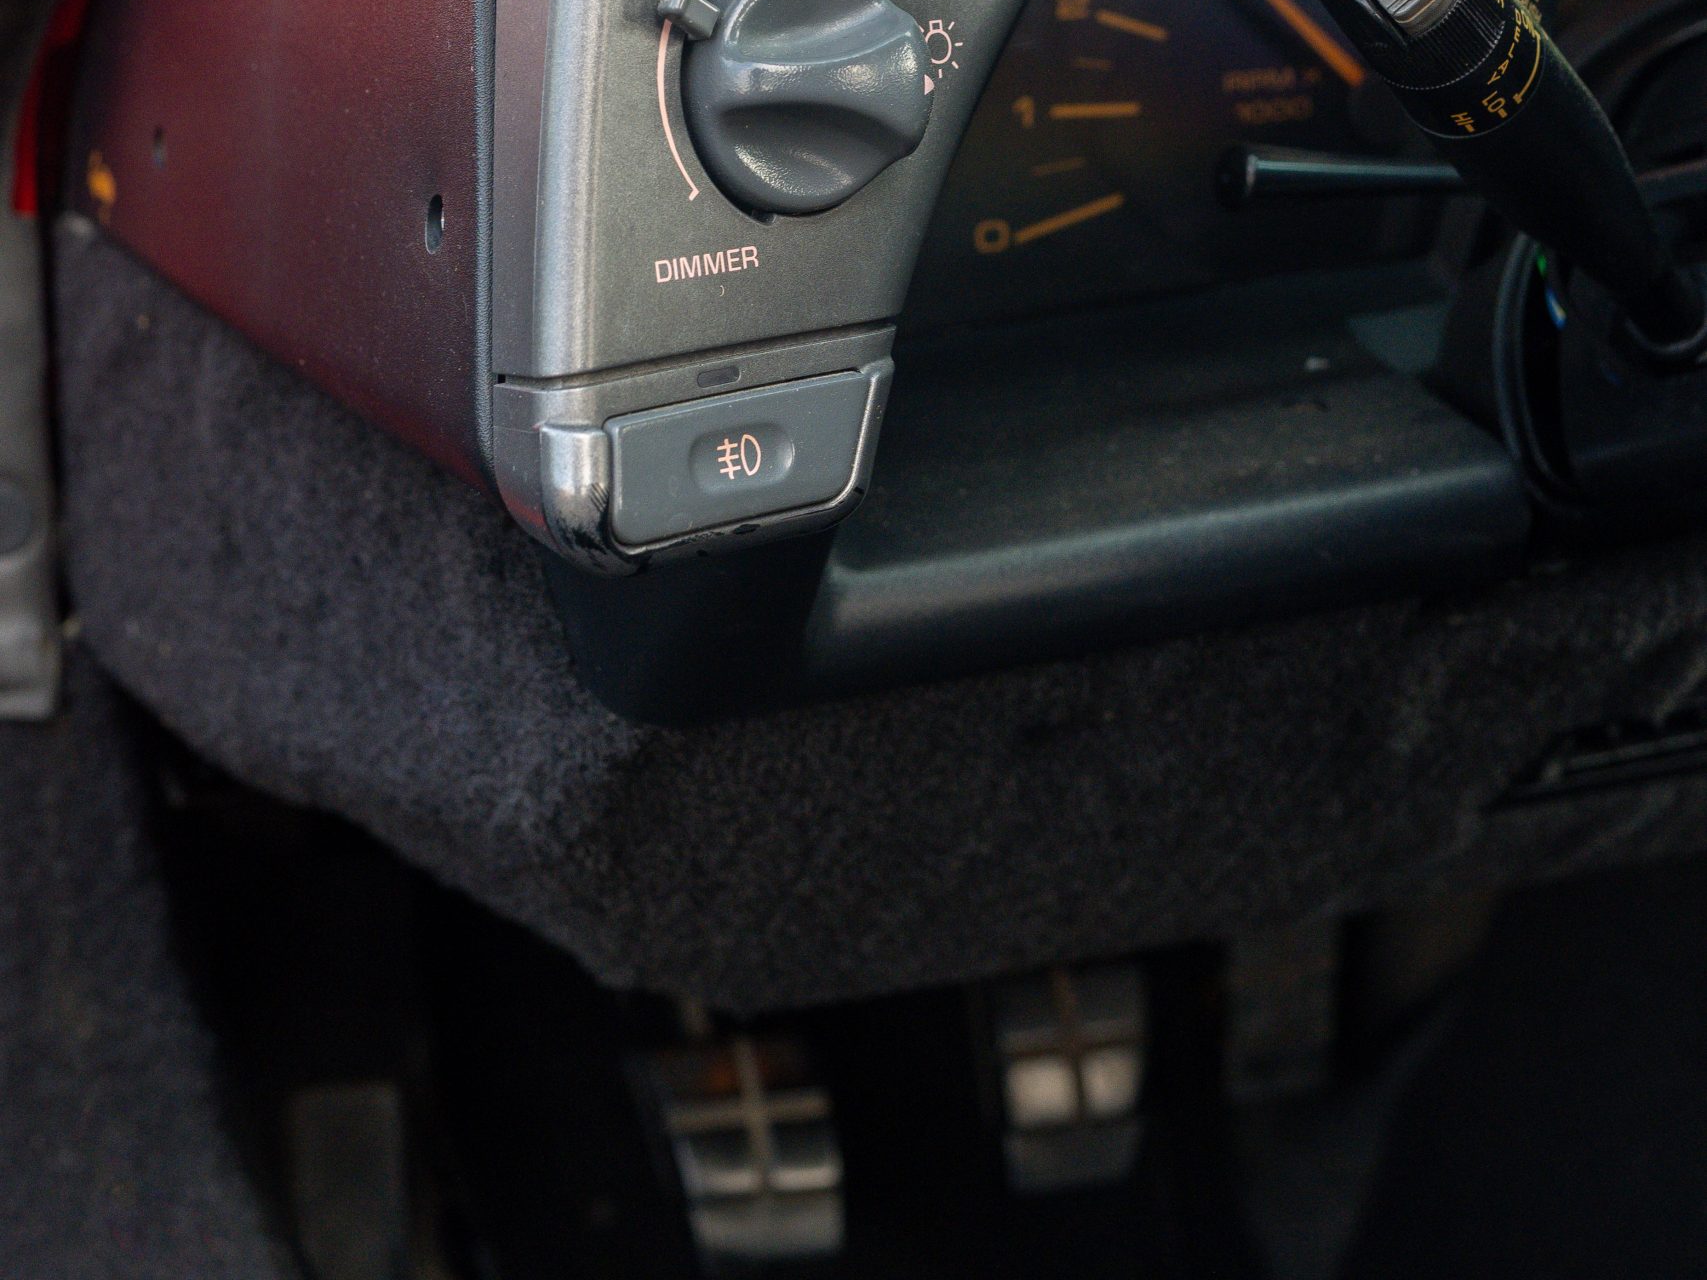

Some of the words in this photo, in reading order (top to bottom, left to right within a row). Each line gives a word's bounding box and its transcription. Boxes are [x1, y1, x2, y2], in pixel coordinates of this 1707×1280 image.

[1487, 7, 1523, 86] DELAY
[1012, 96, 1035, 128] 1
[1481, 90, 1506, 113] LO
[1451, 112, 1474, 126] HI
[974, 220, 1011, 255] 0
[654, 245, 760, 284] DIMMER
